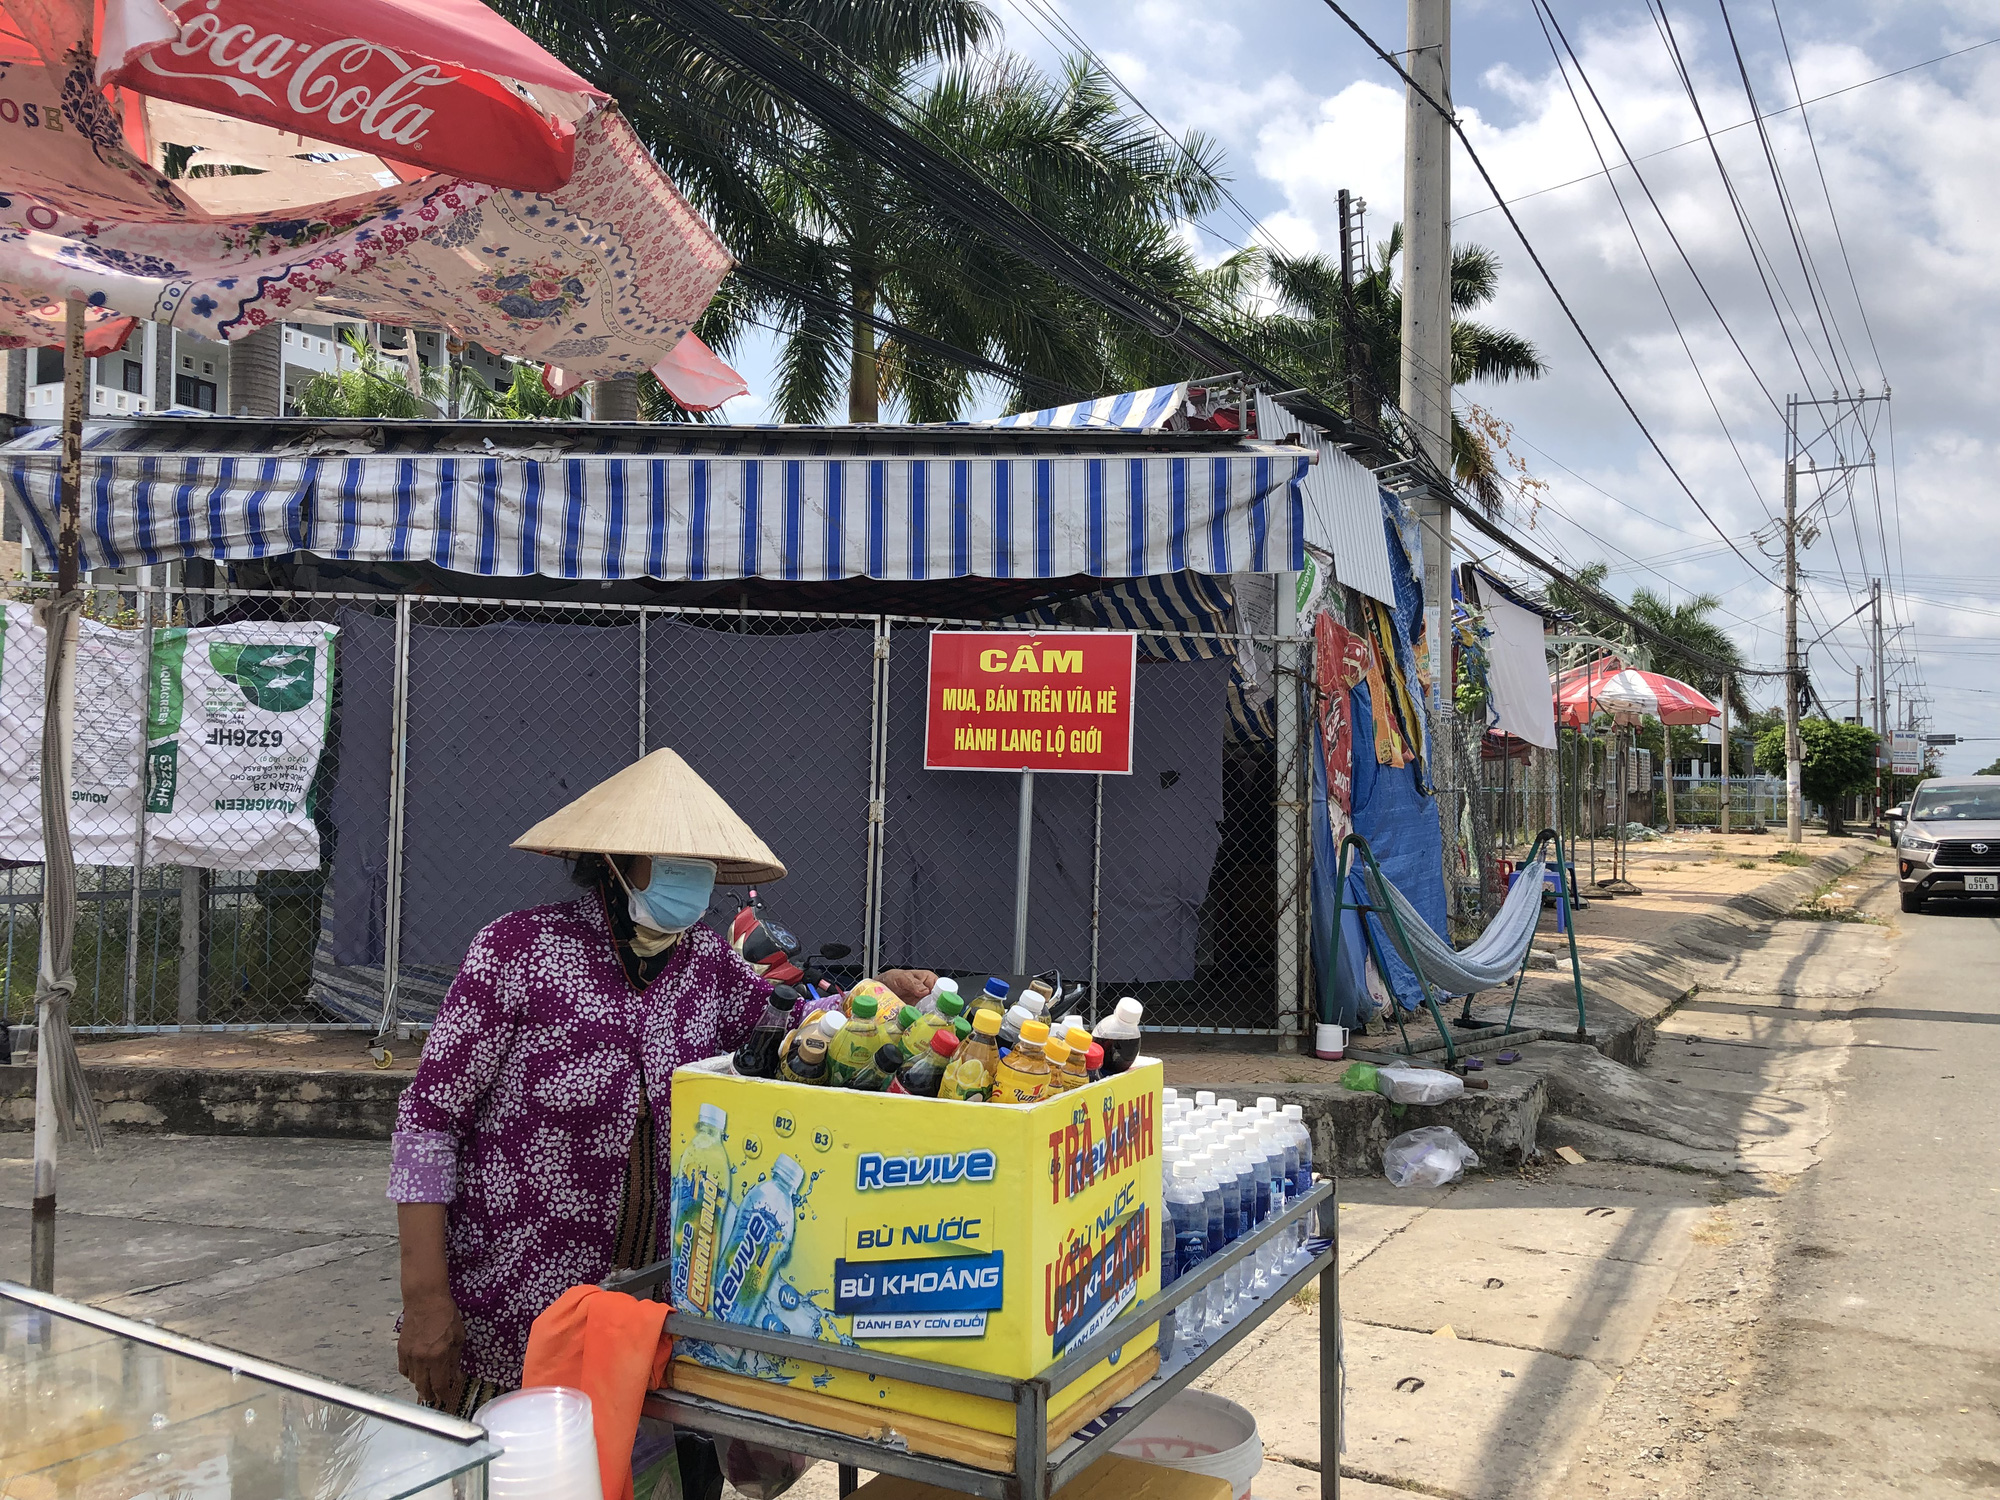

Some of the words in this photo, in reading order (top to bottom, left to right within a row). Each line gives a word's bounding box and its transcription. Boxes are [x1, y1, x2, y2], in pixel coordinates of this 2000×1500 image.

[979, 641, 1084, 674] CẤM
[157, 664, 171, 726] AQUAGREEN
[942, 688, 981, 714] MUA,
[985, 684, 1018, 712] BÁN
[1022, 684, 1062, 713] TRÊN
[1067, 685, 1092, 714] VĨA
[1097, 685, 1117, 714] HÈ
[205, 728, 283, 748] 6326HF
[954, 723, 997, 751] HÀNH
[1001, 728, 1042, 752] LANG
[1046, 724, 1065, 758] LỘ
[1070, 725, 1102, 754] GIỚI
[156, 754, 173, 807] 6326HF
[253, 783, 267, 791] 28
[71, 791, 109, 804] AQUAG
[1103, 1096, 1112, 1113] B3
[775, 1115, 793, 1131] B12
[744, 1138, 758, 1153] B6
[814, 1132, 829, 1146] B3
[1048, 1102, 1095, 1205] TRÀ
[1102, 1091, 1154, 1181] XANH
[857, 1149, 996, 1189] Revive
[1095, 1179, 1135, 1239] NƯỚC
[856, 1223, 894, 1249] BÙ
[901, 1216, 982, 1246] NƯỚC
[675, 1222, 694, 1293] Revive
[713, 1212, 767, 1320] Revive
[840, 1273, 875, 1298] BÙ
[881, 1266, 1000, 1296] KHOÁNG
[780, 1291, 796, 1306] Na
[856, 1318, 892, 1330] ĐÁNH
[894, 1319, 921, 1329] BAY
[924, 1317, 950, 1329] CƠN
[1089, 1314, 1106, 1336] BAY
